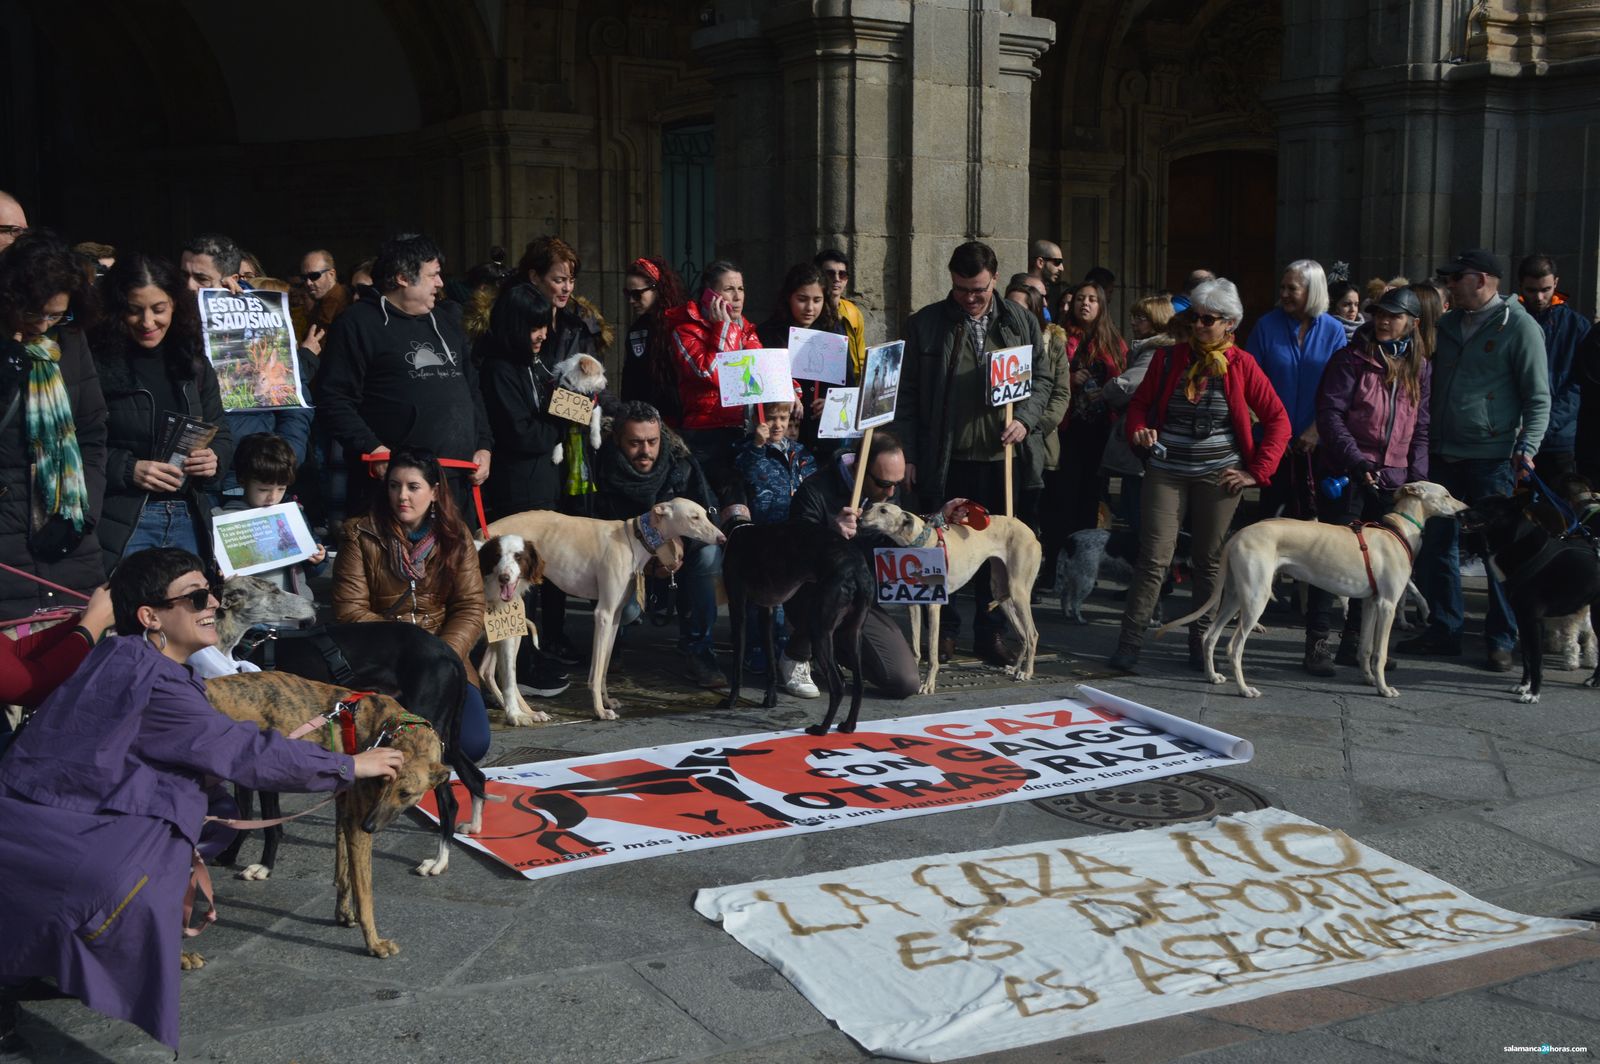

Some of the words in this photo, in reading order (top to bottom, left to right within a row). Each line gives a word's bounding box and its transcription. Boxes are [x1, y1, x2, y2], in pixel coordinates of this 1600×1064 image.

[207, 296, 245, 313] ESTO
[247, 297, 264, 312] ES
[211, 312, 283, 331] SADISMO
[991, 354, 1020, 388] NO
[556, 389, 589, 409] STOP
[991, 379, 1031, 404] CAZA
[554, 403, 586, 424] CAZA
[875, 553, 923, 585] NO
[932, 565, 942, 574] la
[878, 582, 947, 602] CAZA
[487, 613, 525, 633] SOMOS
[496, 625, 526, 640] ARMAS
[808, 747, 852, 760] A
[852, 737, 935, 753] LA
[805, 756, 932, 779] CON
[622, 836, 673, 851] más
[677, 821, 788, 842] indefensa
[792, 813, 841, 826] está
[846, 807, 885, 819] una
[889, 794, 977, 812] criatura,
[978, 784, 1018, 798] más
[1024, 775, 1096, 793] derecho
[1100, 766, 1144, 781] tiene
[1146, 763, 1159, 772] a
[1162, 759, 1188, 769] ser
[676, 809, 727, 826] Y
[782, 764, 1042, 810] OTRAS
[754, 882, 921, 936] LA
[911, 848, 1168, 908] CAZA
[1168, 821, 1363, 877] NO
[896, 918, 1026, 972] ES
[1070, 867, 1458, 937] DEPORTE
[1004, 969, 1100, 1018] ES
[1123, 908, 1531, 996] ASESINATO
